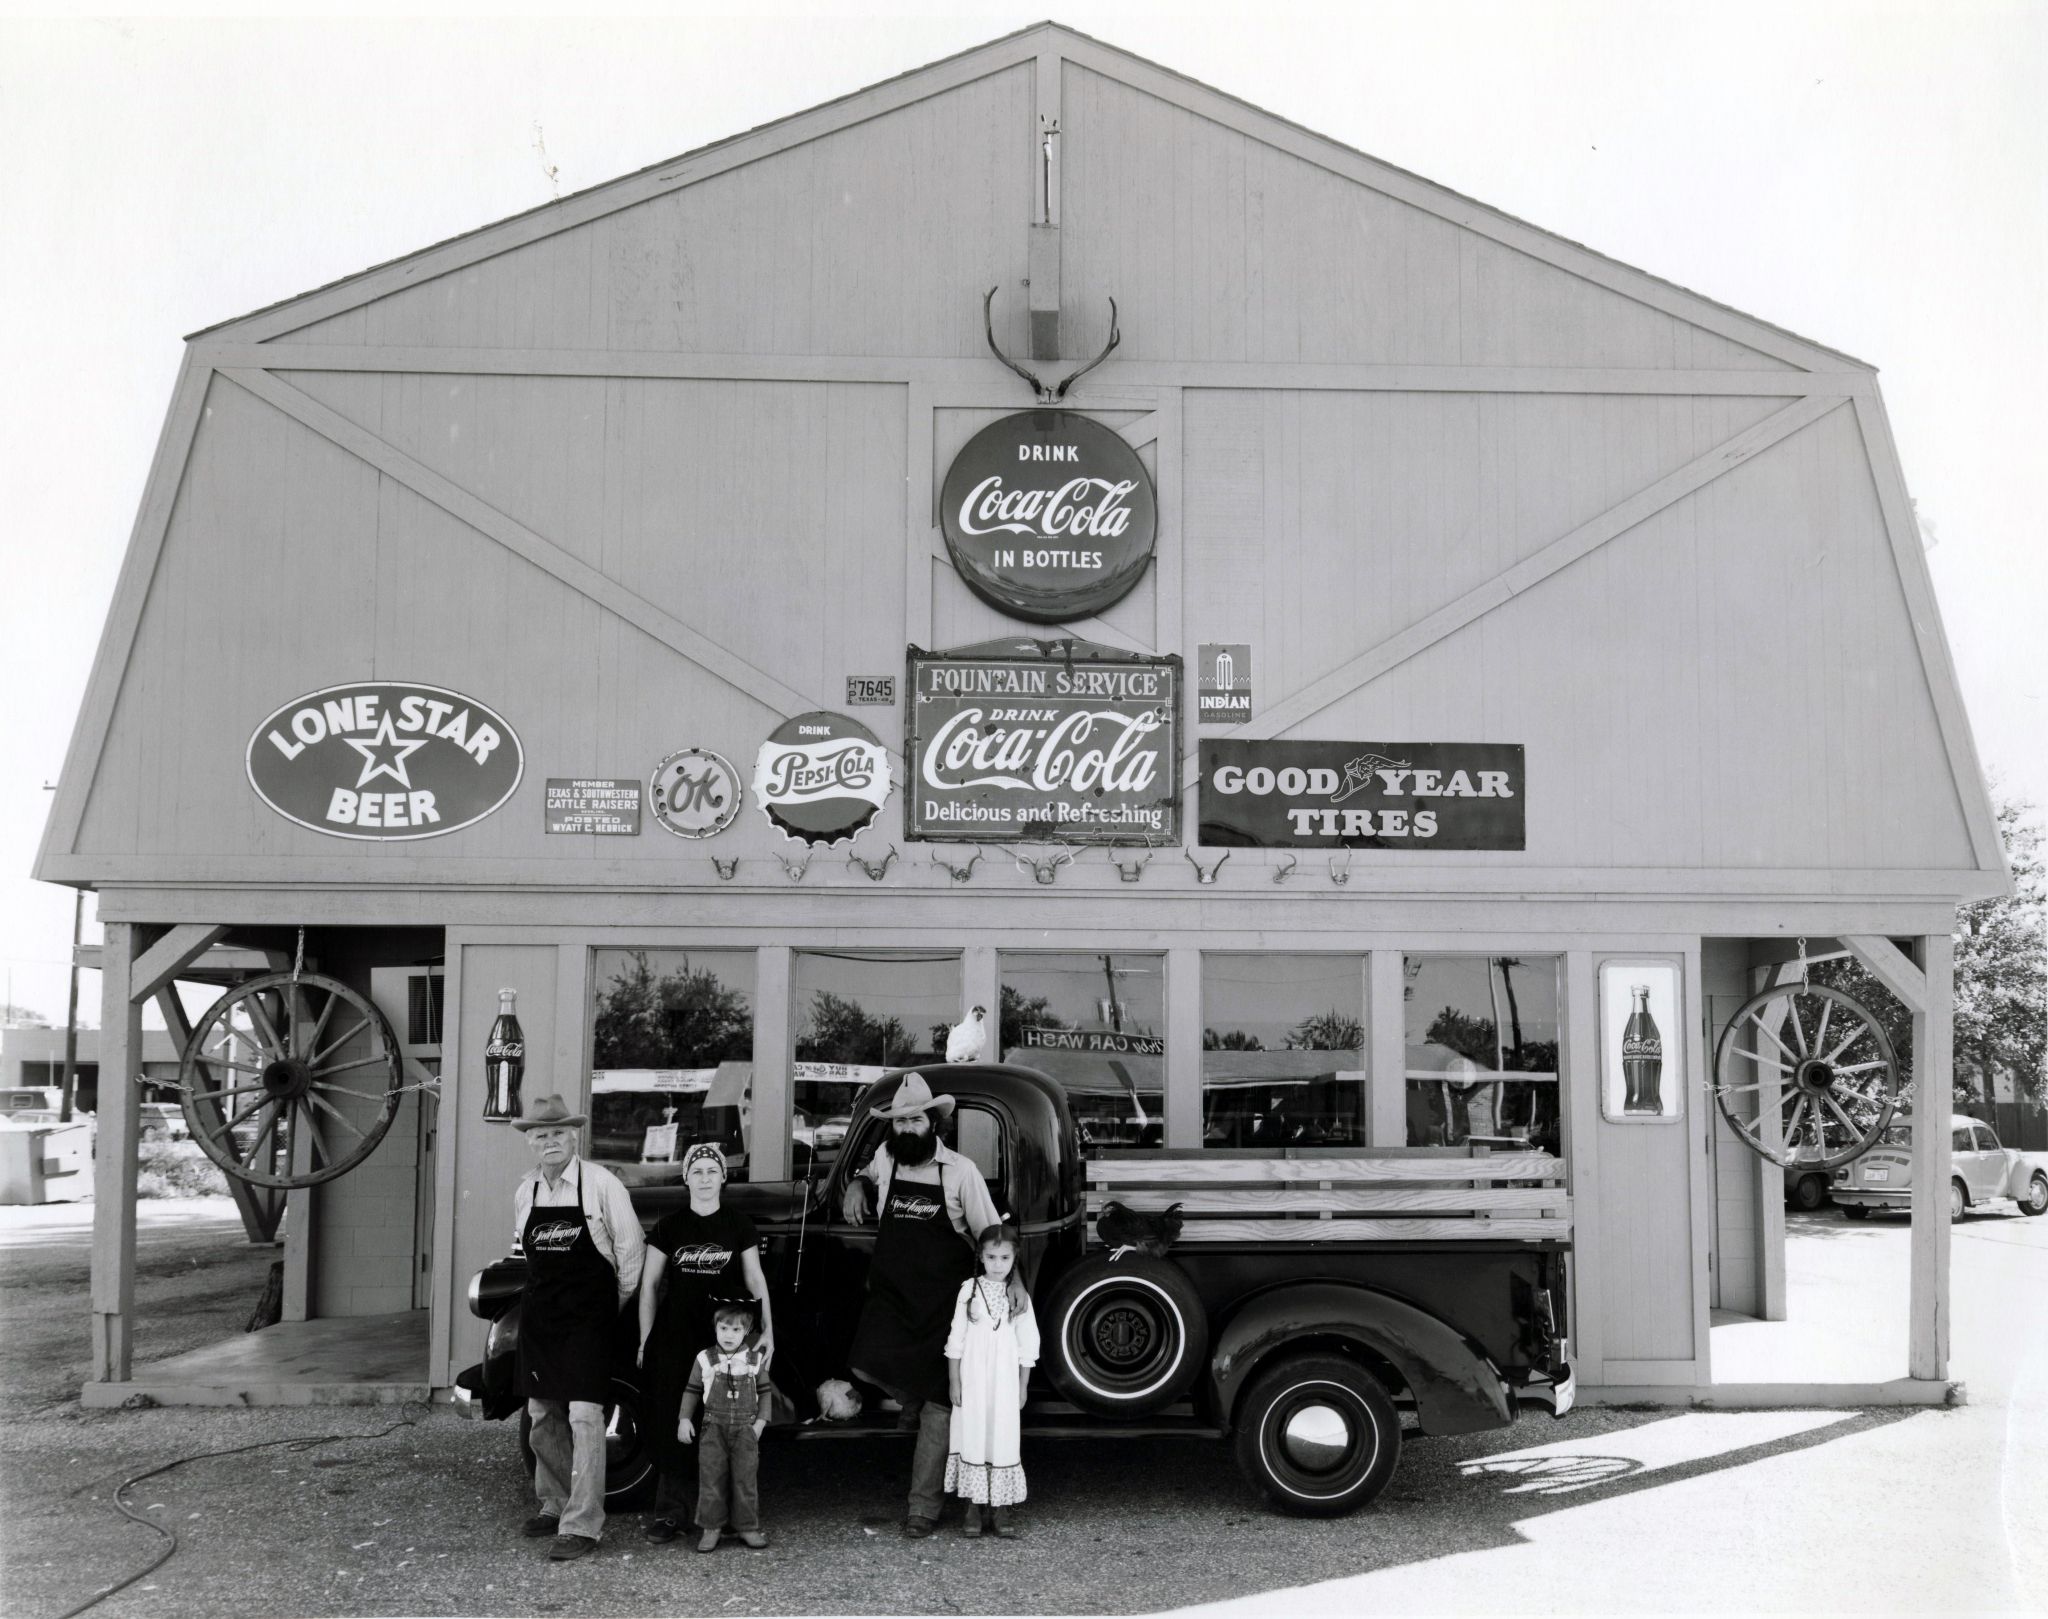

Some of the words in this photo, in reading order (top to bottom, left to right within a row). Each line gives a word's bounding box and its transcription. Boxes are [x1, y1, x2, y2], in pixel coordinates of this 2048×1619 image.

[1019, 444, 1079, 462] DRINK
[958, 475, 1140, 537] Coca-Cola
[994, 550, 1014, 568] IN
[1023, 550, 1102, 569] BOTTLES
[857, 680, 892, 696] 7645
[930, 669, 1046, 693] FOUNTAIN
[1056, 671, 1158, 696] SERVICE
[1200, 693, 1250, 708] INDIAN
[983, 709, 1060, 721] DRINK
[267, 695, 379, 761] LONE
[396, 695, 501, 766] STAR
[798, 725, 831, 736] DRINK
[922, 708, 1165, 792] Coca-Cola
[666, 767, 724, 813] OK
[1213, 765, 1340, 796] GOOD
[1375, 769, 1515, 799] YEAR
[548, 788, 571, 798] TEXAS
[573, 789, 580, 798] &
[582, 789, 639, 799] SOUTHWESTERN
[326, 787, 441, 827] BEER
[547, 799, 587, 809] CATTLE
[592, 800, 639, 810] RAISERS
[564, 816, 621, 824] POSTED
[924, 801, 1011, 822] Delicious
[1016, 802, 1050, 823] and
[1057, 803, 1163, 829] Refreshing
[1287, 808, 1439, 838] TIRES
[552, 824, 582, 832] WYATT
[486, 1042, 523, 1057] Coca-Cola
[1623, 1038, 1662, 1054] Coca-Cola
